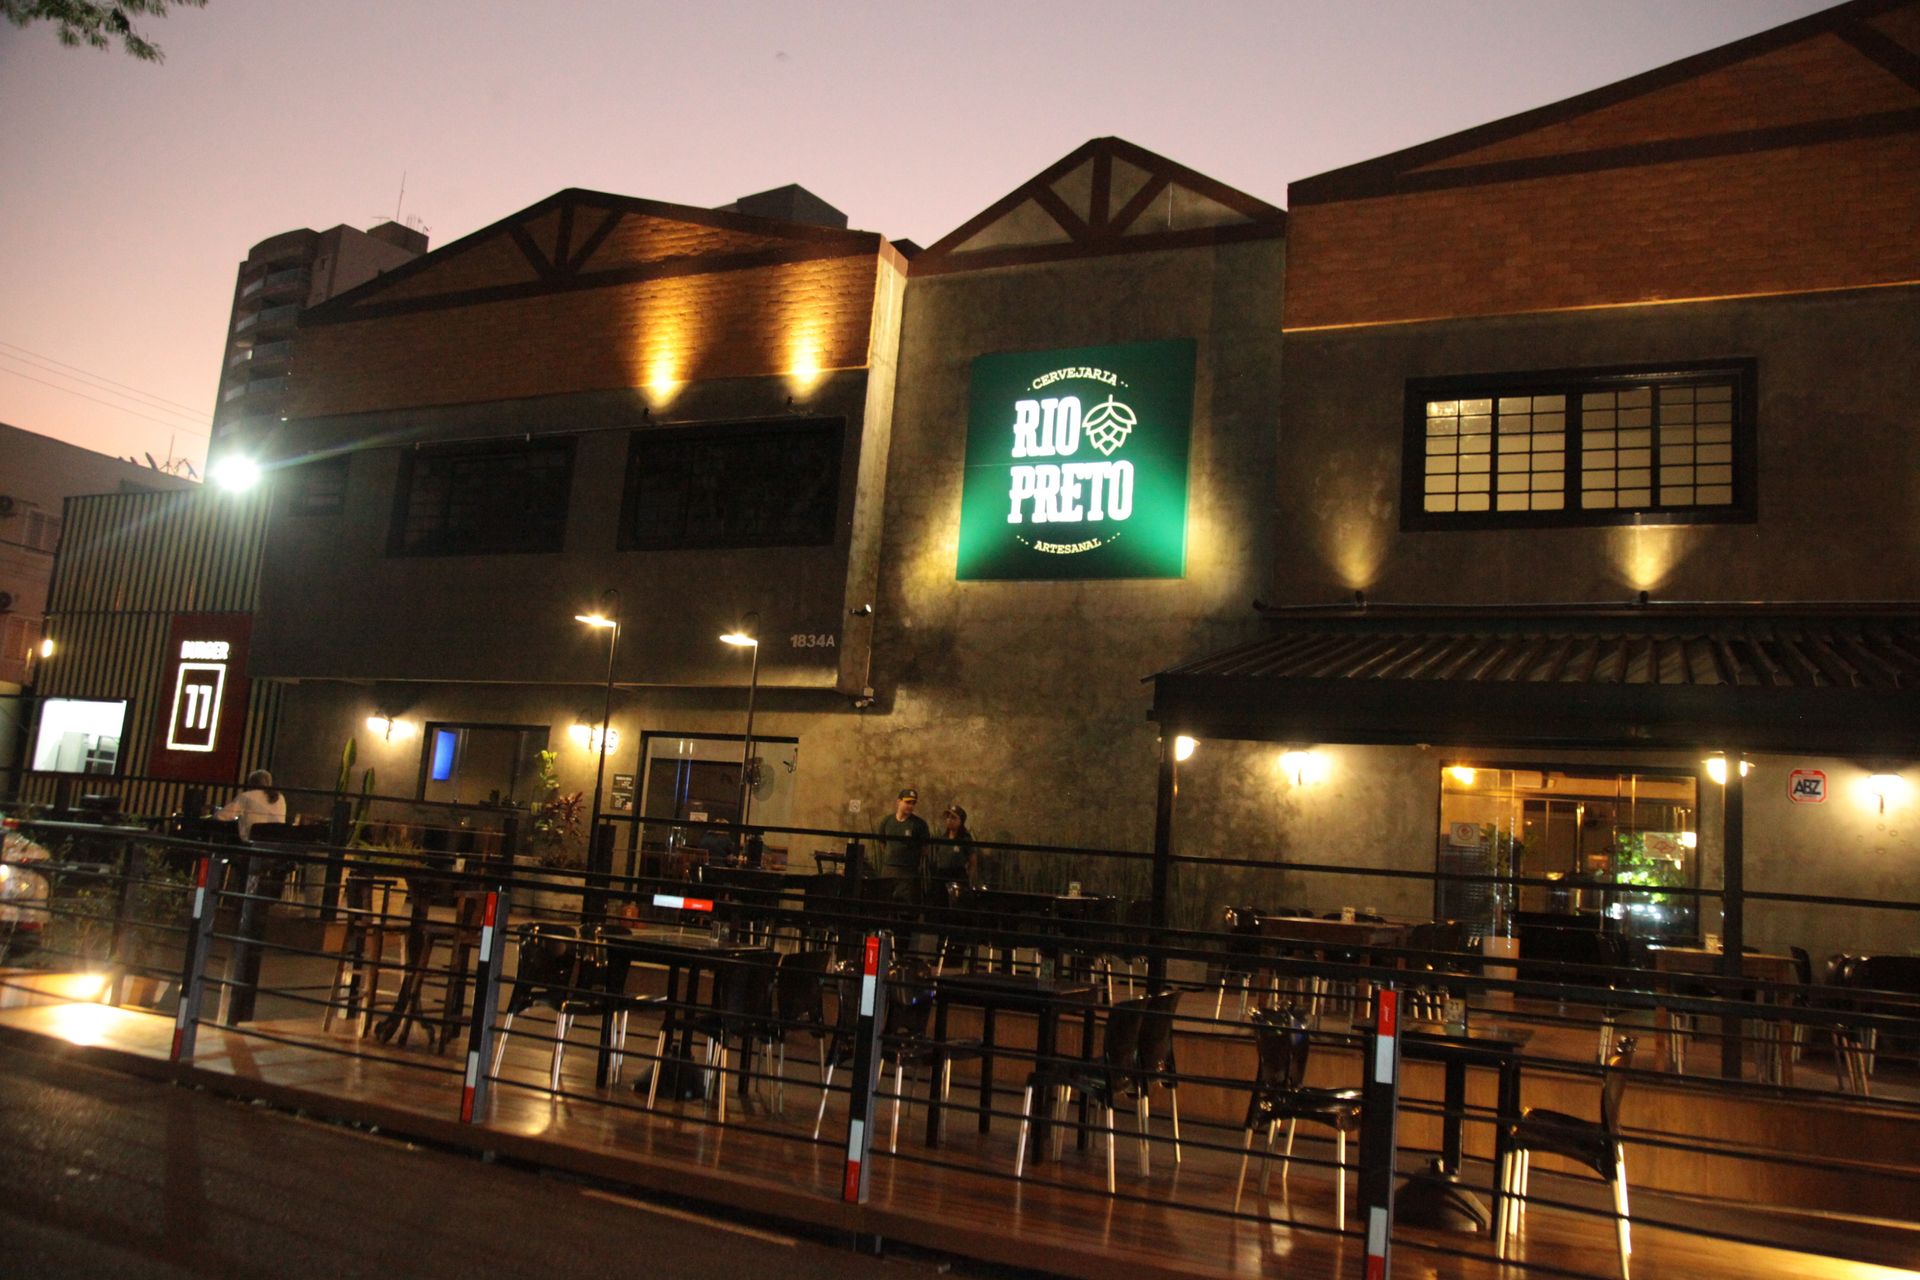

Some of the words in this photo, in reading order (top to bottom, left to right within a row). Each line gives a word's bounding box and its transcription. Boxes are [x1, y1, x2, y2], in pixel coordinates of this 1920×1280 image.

[1032, 367, 1117, 389] CERVEJARIA
[1012, 396, 1081, 457] RIO
[1007, 460, 1134, 523] PRETO
[1033, 537, 1102, 554] ARTESANAL
[790, 634, 836, 648] 1834A
[185, 684, 213, 729] 11
